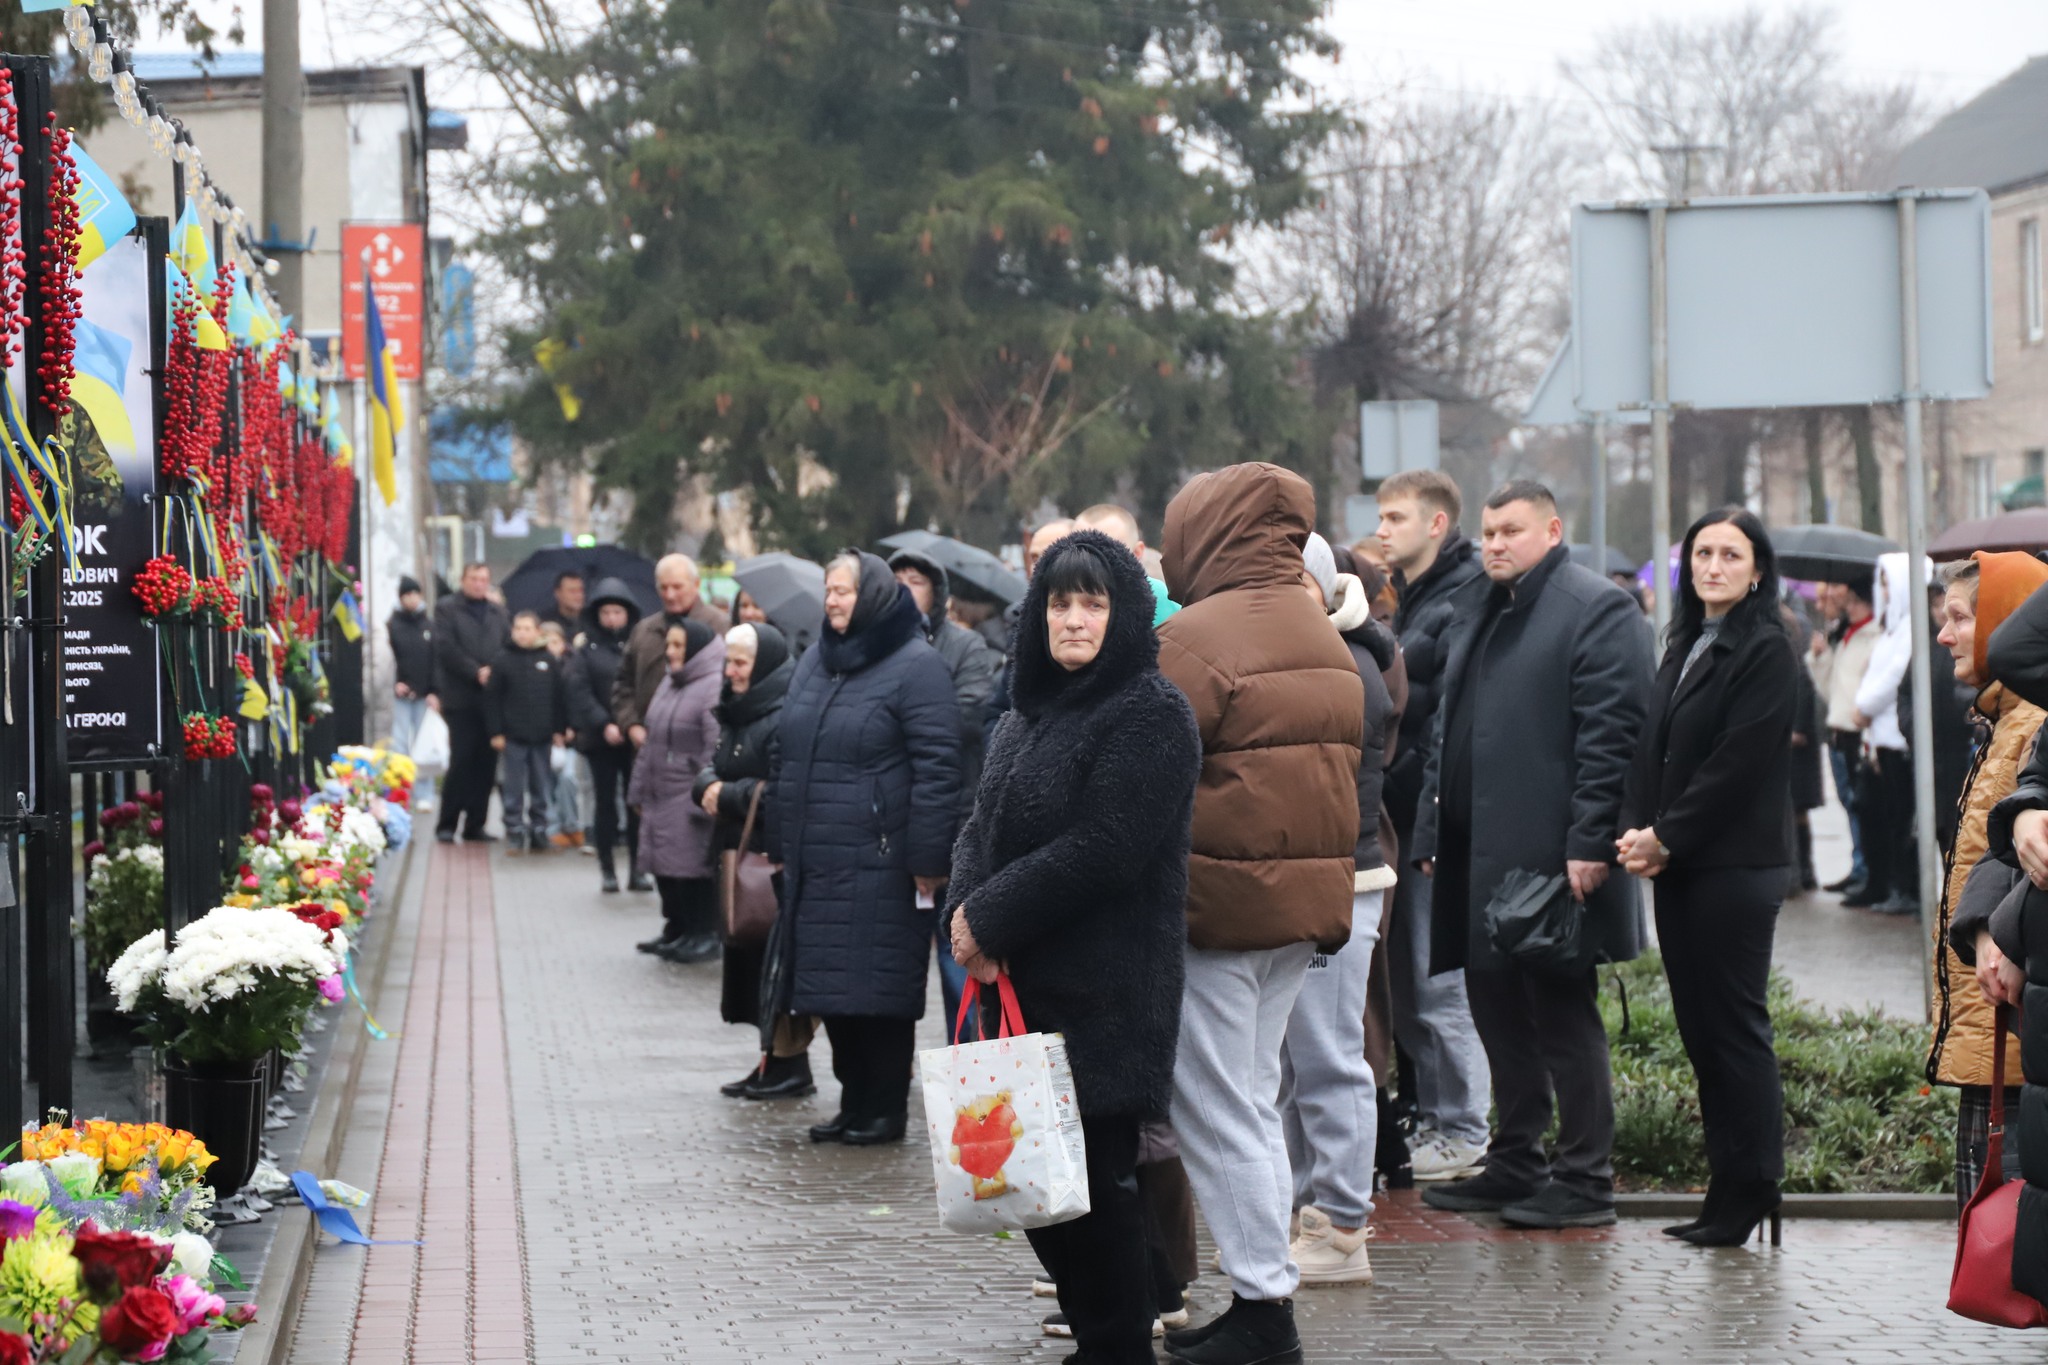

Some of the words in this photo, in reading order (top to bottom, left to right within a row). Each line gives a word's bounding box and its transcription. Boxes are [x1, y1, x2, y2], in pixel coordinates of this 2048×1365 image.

[92, 643, 131, 655] УКРАЇНИ,
[65, 661, 103, 671] ПРИСЯЗІ,
[73, 711, 126, 728] ГЕРОЮ!
